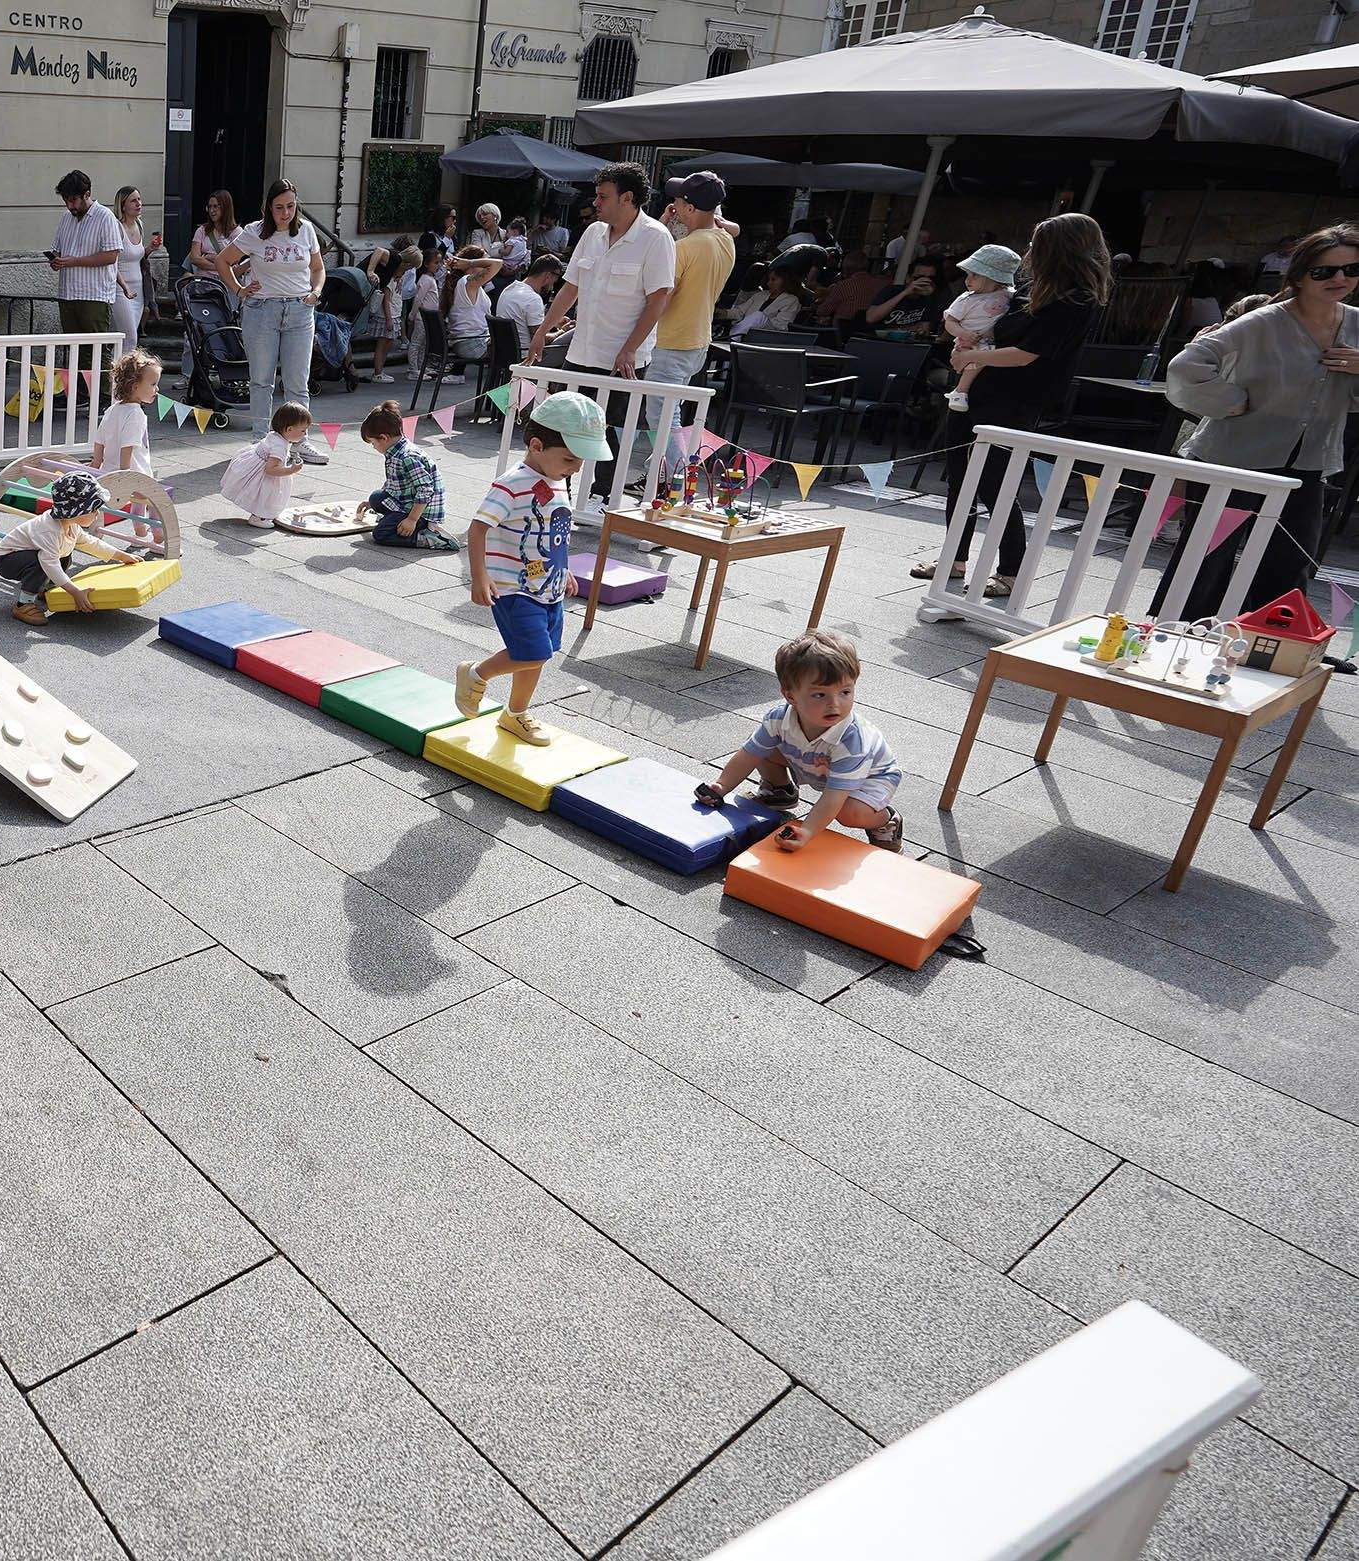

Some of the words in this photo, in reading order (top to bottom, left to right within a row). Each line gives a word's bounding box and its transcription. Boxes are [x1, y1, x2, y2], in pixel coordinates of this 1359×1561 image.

[9, 11, 83, 31] CENTRO
[10, 44, 80, 85] Méndez
[87, 49, 138, 88] Núñez
[508, 33, 568, 68] Gramola
